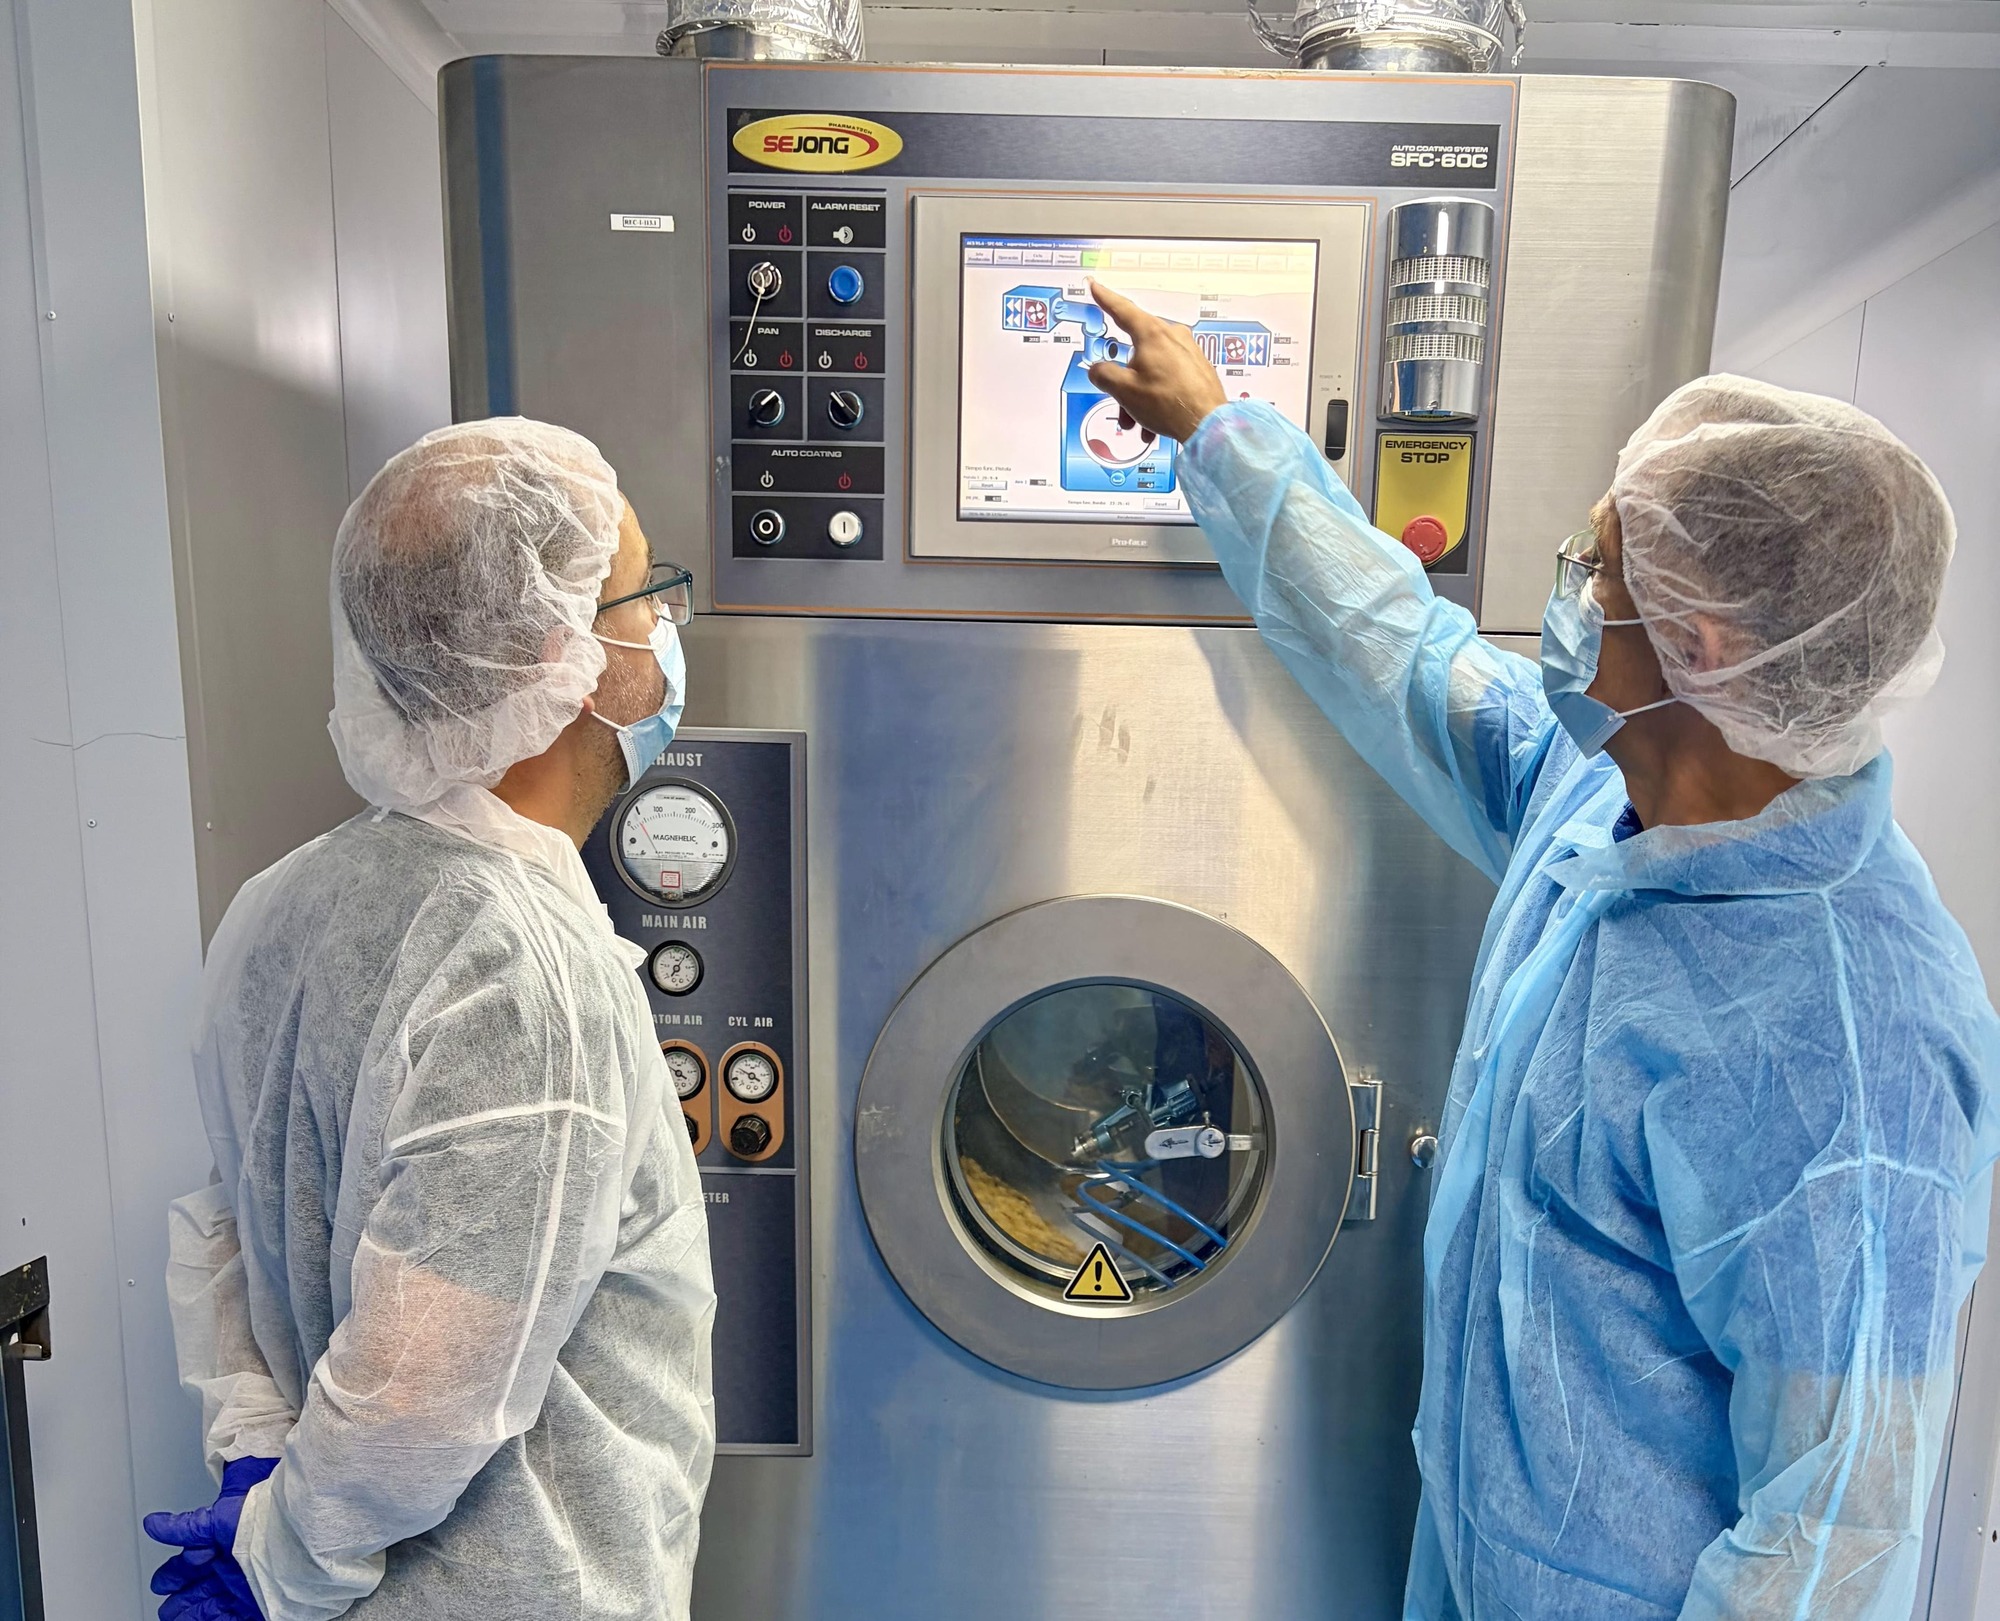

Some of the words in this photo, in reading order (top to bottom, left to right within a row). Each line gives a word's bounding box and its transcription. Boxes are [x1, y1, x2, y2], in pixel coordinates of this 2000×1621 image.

[828, 122, 873, 135] PHARMATECH
[763, 135, 850, 155] SEJONG
[1390, 152, 1488, 169] SFC-60C
[748, 201, 786, 209] POWER
[811, 202, 848, 211] ALARM
[849, 203, 881, 212] RESET
[757, 327, 779, 335] PAN
[815, 328, 872, 338] DISCHARGE
[1385, 440, 1468, 450] EMERGENCY
[771, 449, 798, 457] AUTO
[799, 449, 842, 458] COATING
[1401, 452, 1450, 464] STOP
[652, 752, 703, 767] HAUST
[653, 834, 696, 843] MAGNEHELIC
[642, 914, 678, 928] MAIN
[682, 915, 707, 929] AIR
[653, 1014, 681, 1025] ATOM
[683, 1014, 703, 1025] AIR
[728, 1016, 748, 1027] CYL
[754, 1016, 774, 1027] AIR
[702, 1192, 729, 1203] ETER
